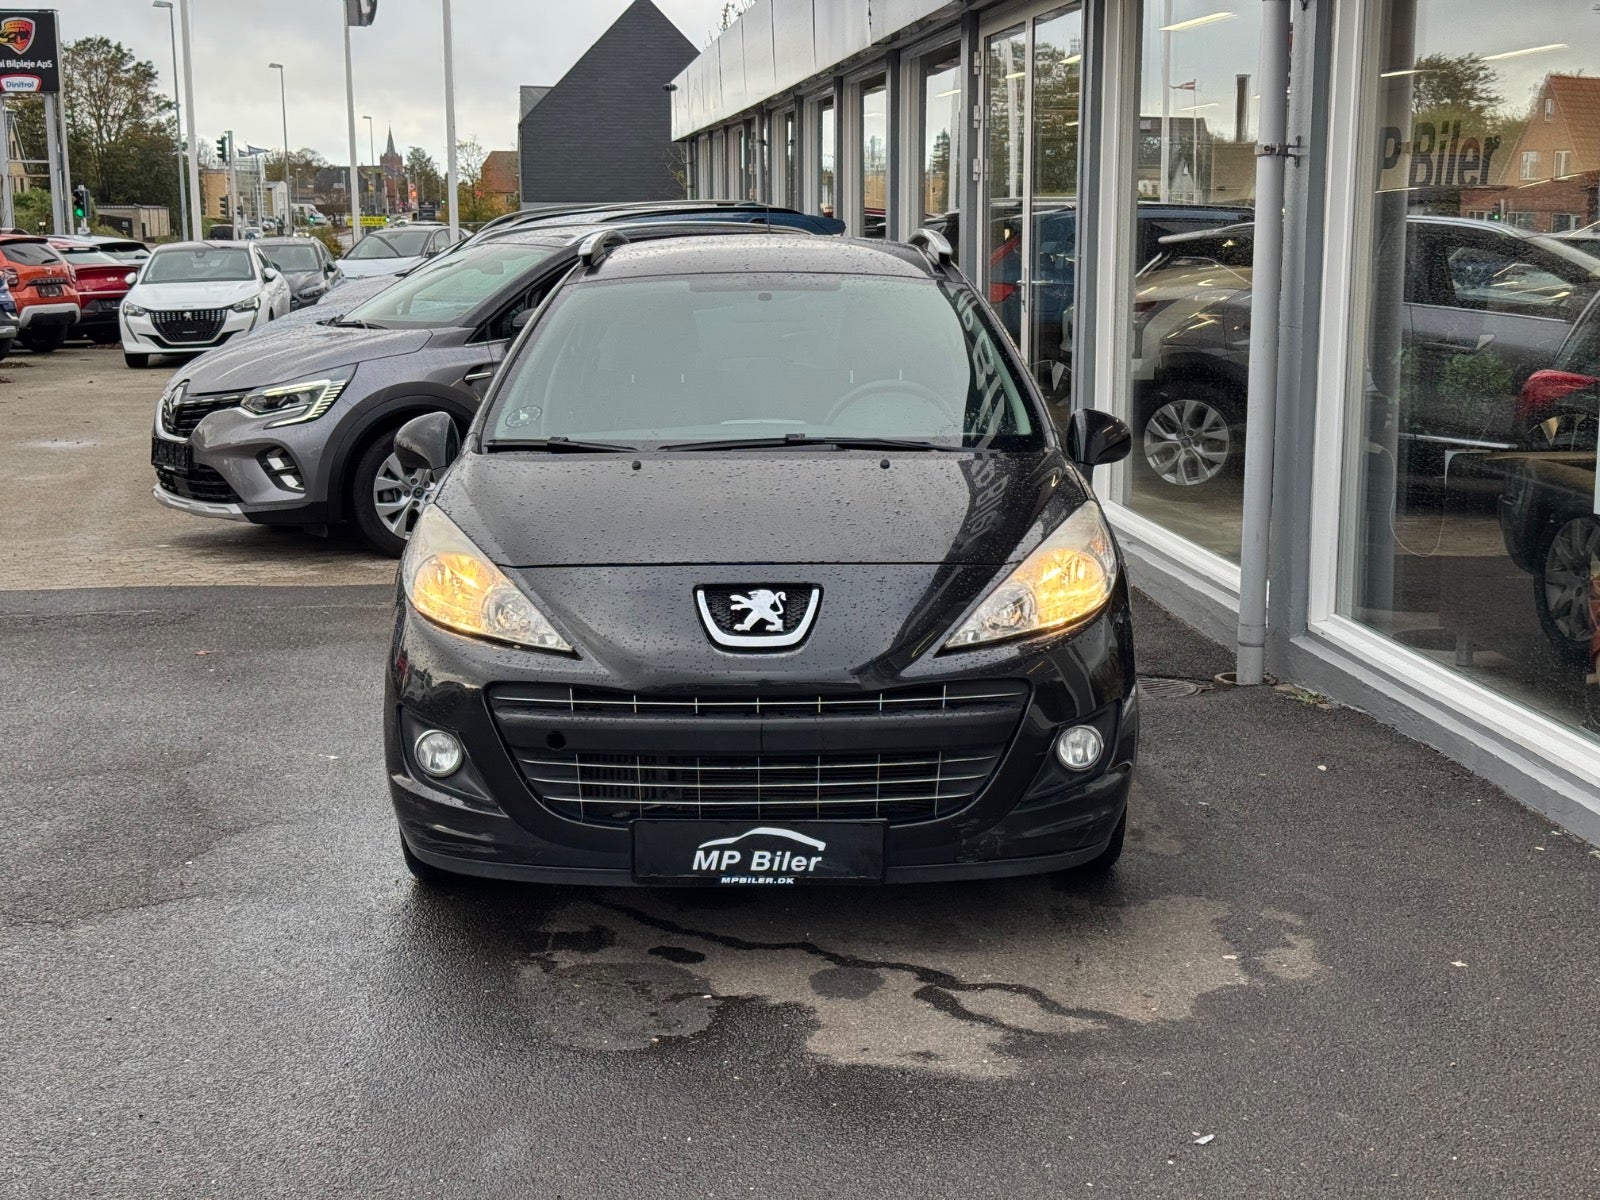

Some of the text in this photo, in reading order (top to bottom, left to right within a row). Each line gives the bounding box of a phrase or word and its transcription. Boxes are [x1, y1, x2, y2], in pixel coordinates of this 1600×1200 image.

[6, 59, 36, 69] Bilpleje
[36, 60, 53, 69] ApS
[1408, 119, 1501, 187] Biler
[692, 850, 823, 872] MP Biler
[720, 876, 795, 884] MPBILER.DK
